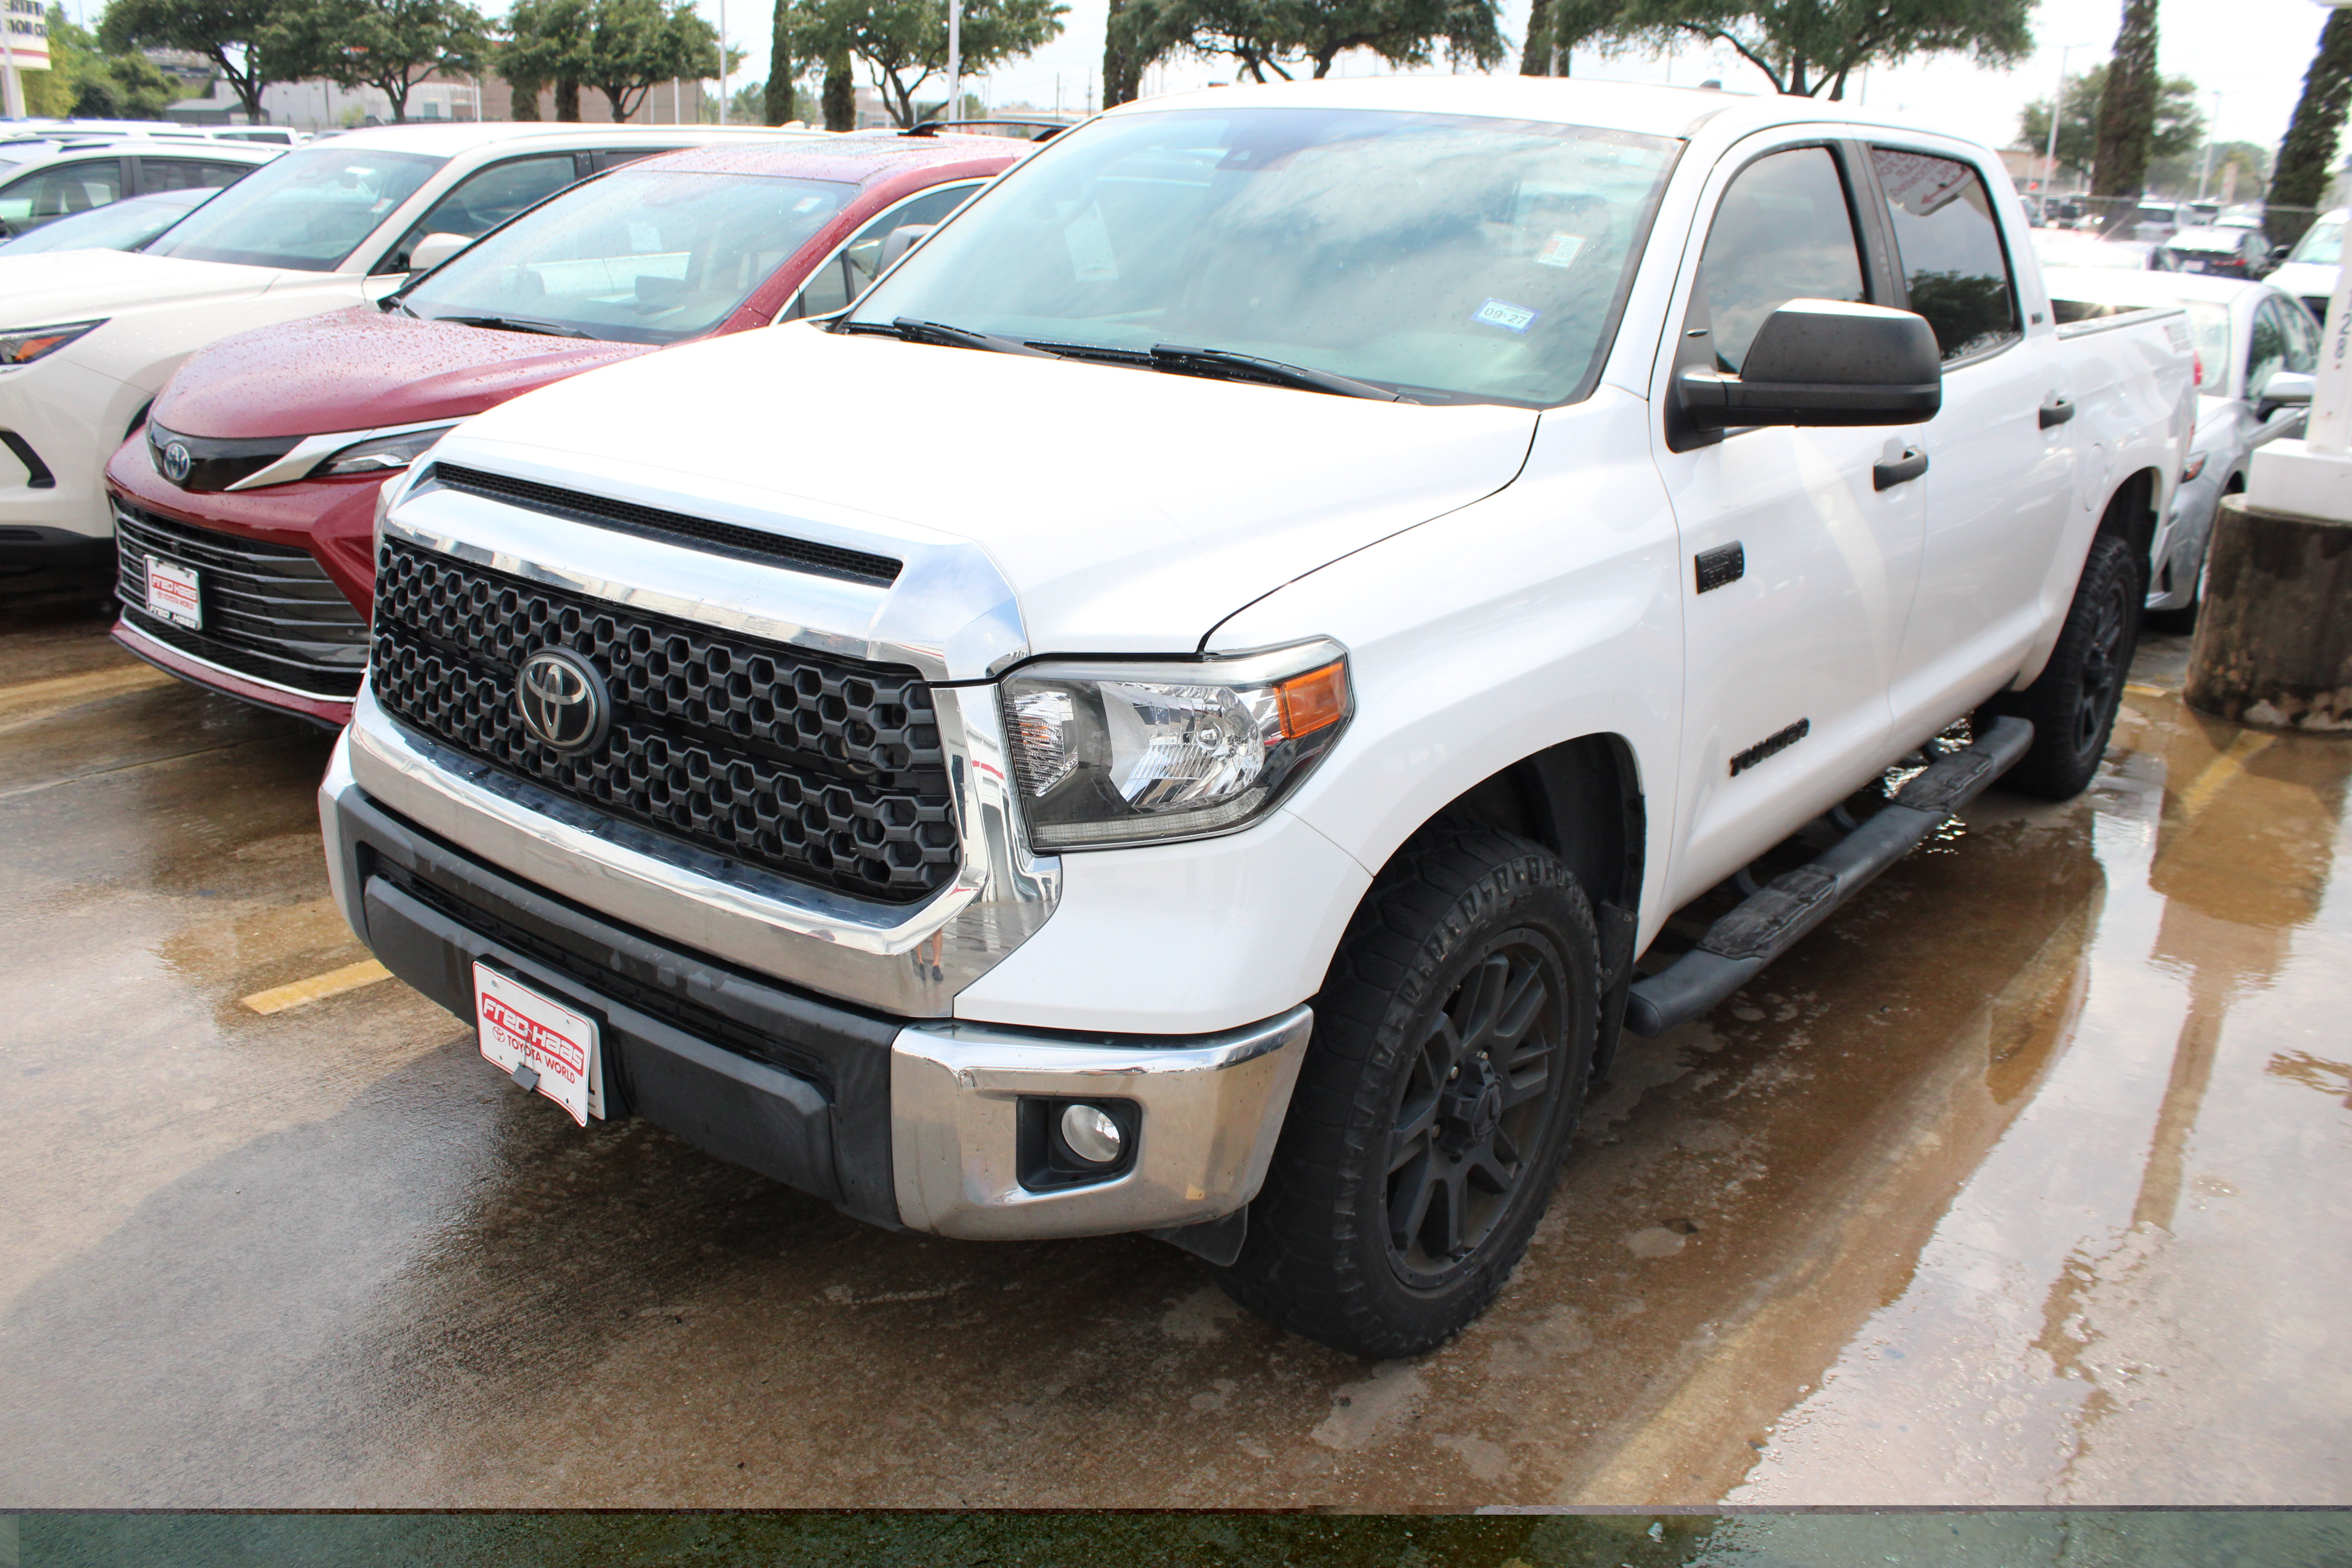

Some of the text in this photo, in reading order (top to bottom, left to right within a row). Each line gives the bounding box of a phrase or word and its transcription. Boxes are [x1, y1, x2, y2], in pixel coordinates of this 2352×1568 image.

[1730, 717, 1810, 777] TUNDRA
[507, 1034, 575, 1084] TOYOTA WORLD
